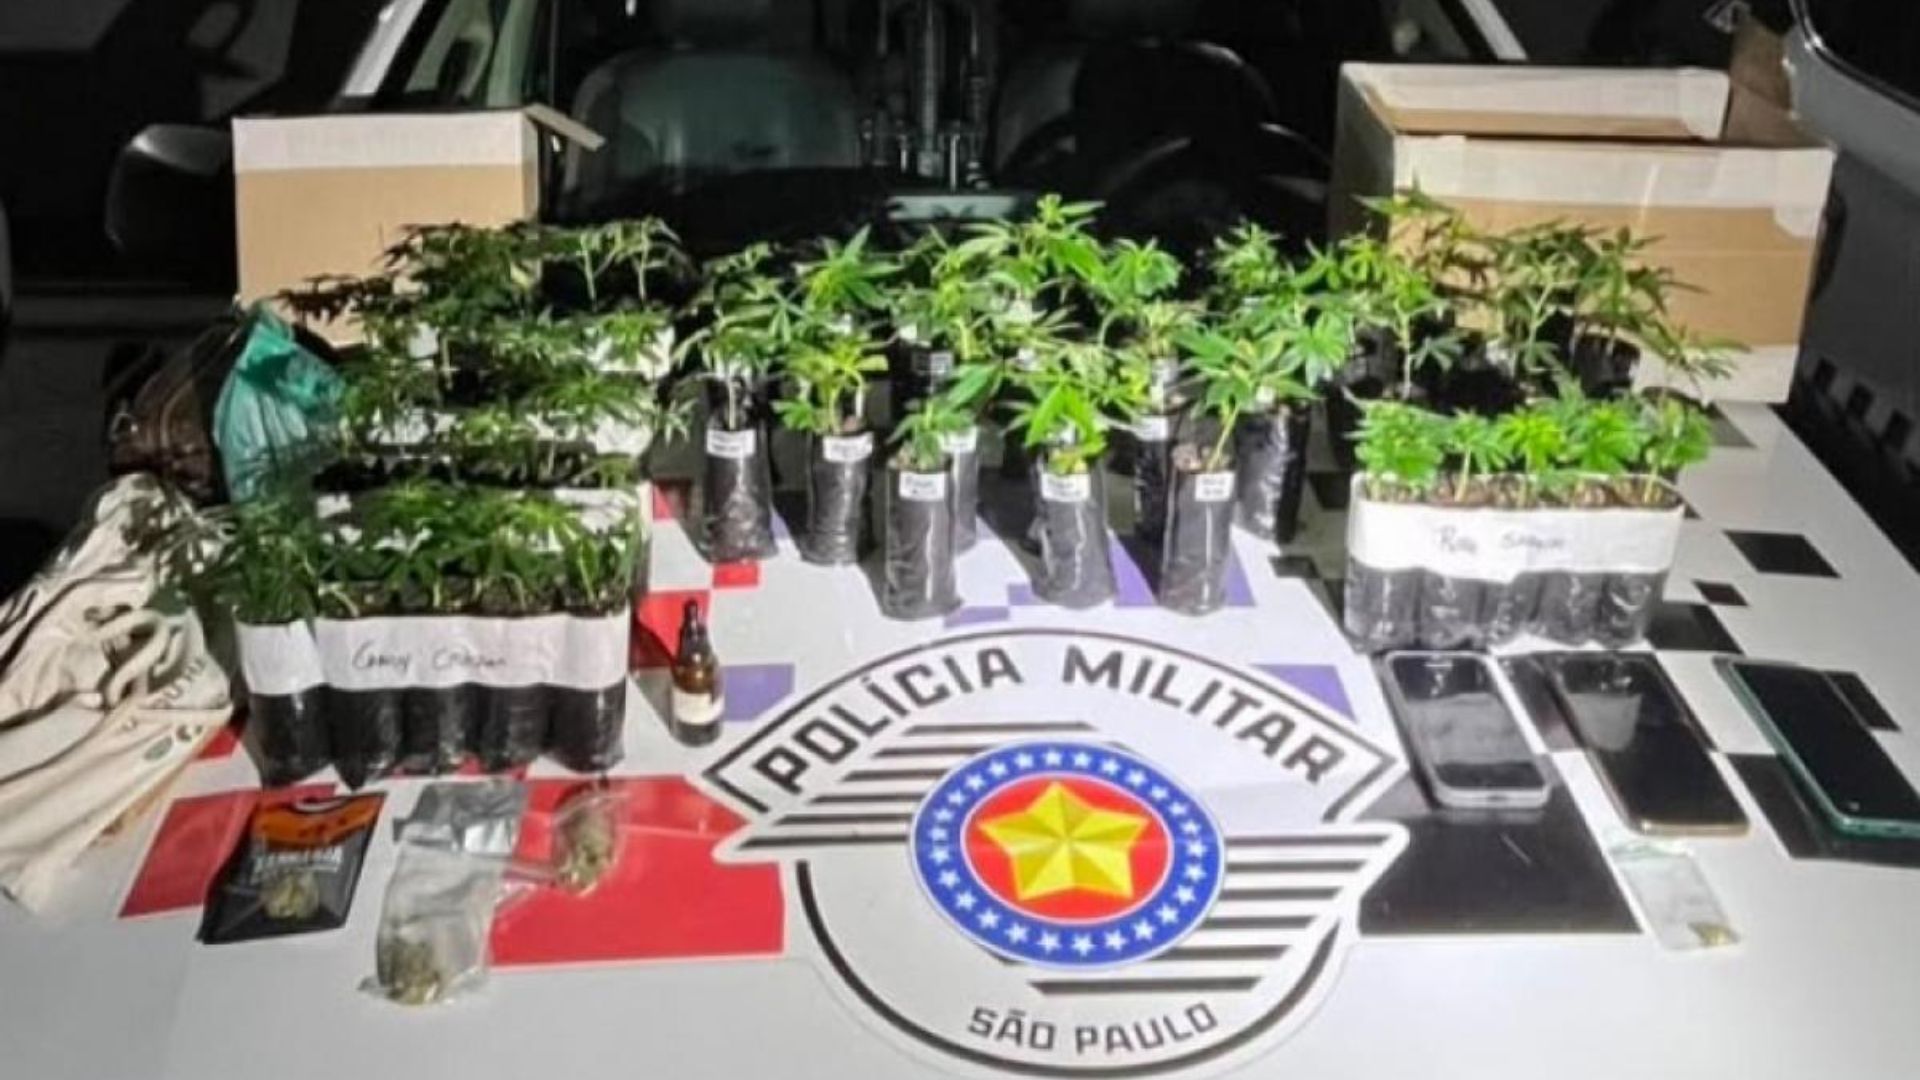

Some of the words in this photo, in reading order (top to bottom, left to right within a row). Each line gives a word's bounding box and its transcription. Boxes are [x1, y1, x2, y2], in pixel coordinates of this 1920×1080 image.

[752, 647, 1023, 795] POLÍCIA
[1062, 644, 1345, 784] MILITAR
[967, 1006, 1057, 1051] SÃO
[1074, 1001, 1219, 1056] PAULO
